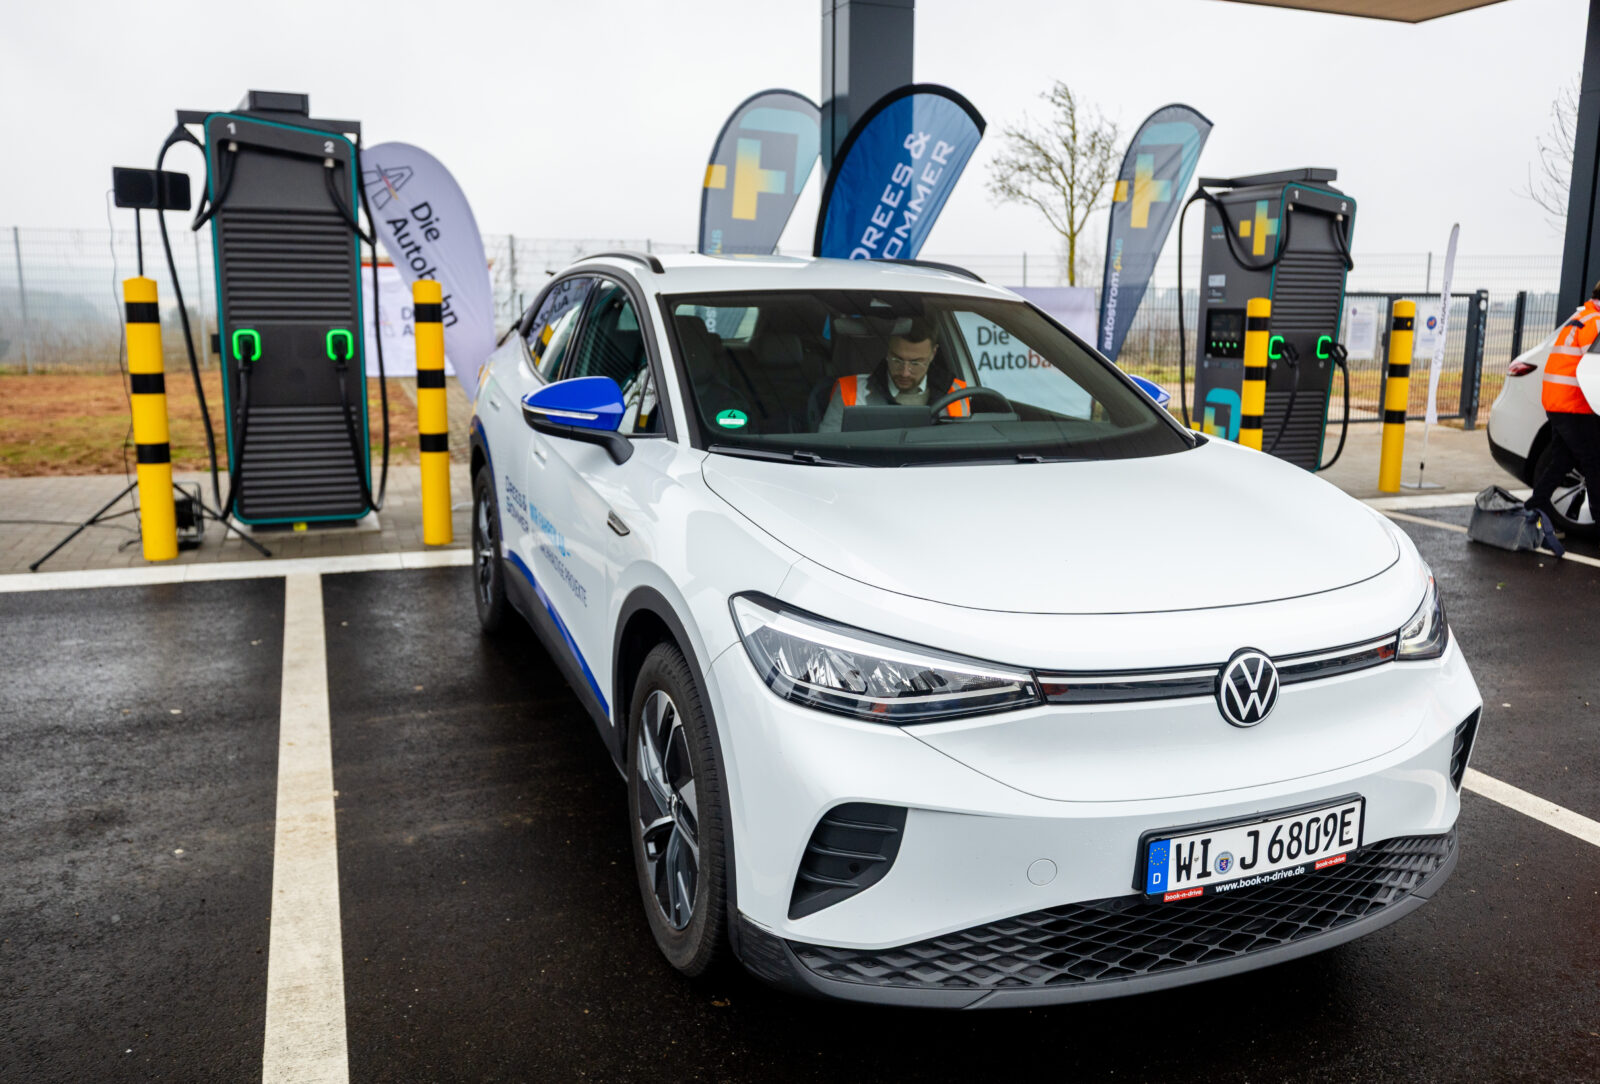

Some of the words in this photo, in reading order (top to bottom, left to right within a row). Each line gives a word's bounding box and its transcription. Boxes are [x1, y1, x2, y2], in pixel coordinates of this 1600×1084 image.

[226, 122, 236, 135] 1
[324, 140, 335, 153] 2
[903, 131, 930, 159] &
[410, 201, 441, 242] Die
[977, 325, 1010, 346] Die
[1175, 838, 1212, 883] WI
[1239, 830, 1260, 870] J
[1267, 807, 1356, 864] 6809E
[1315, 855, 1346, 869] book-n-drive
[1152, 872, 1161, 885] D
[1215, 866, 1305, 893] www.book-n-drive.de
[1165, 889, 1203, 901] book-n-drive
